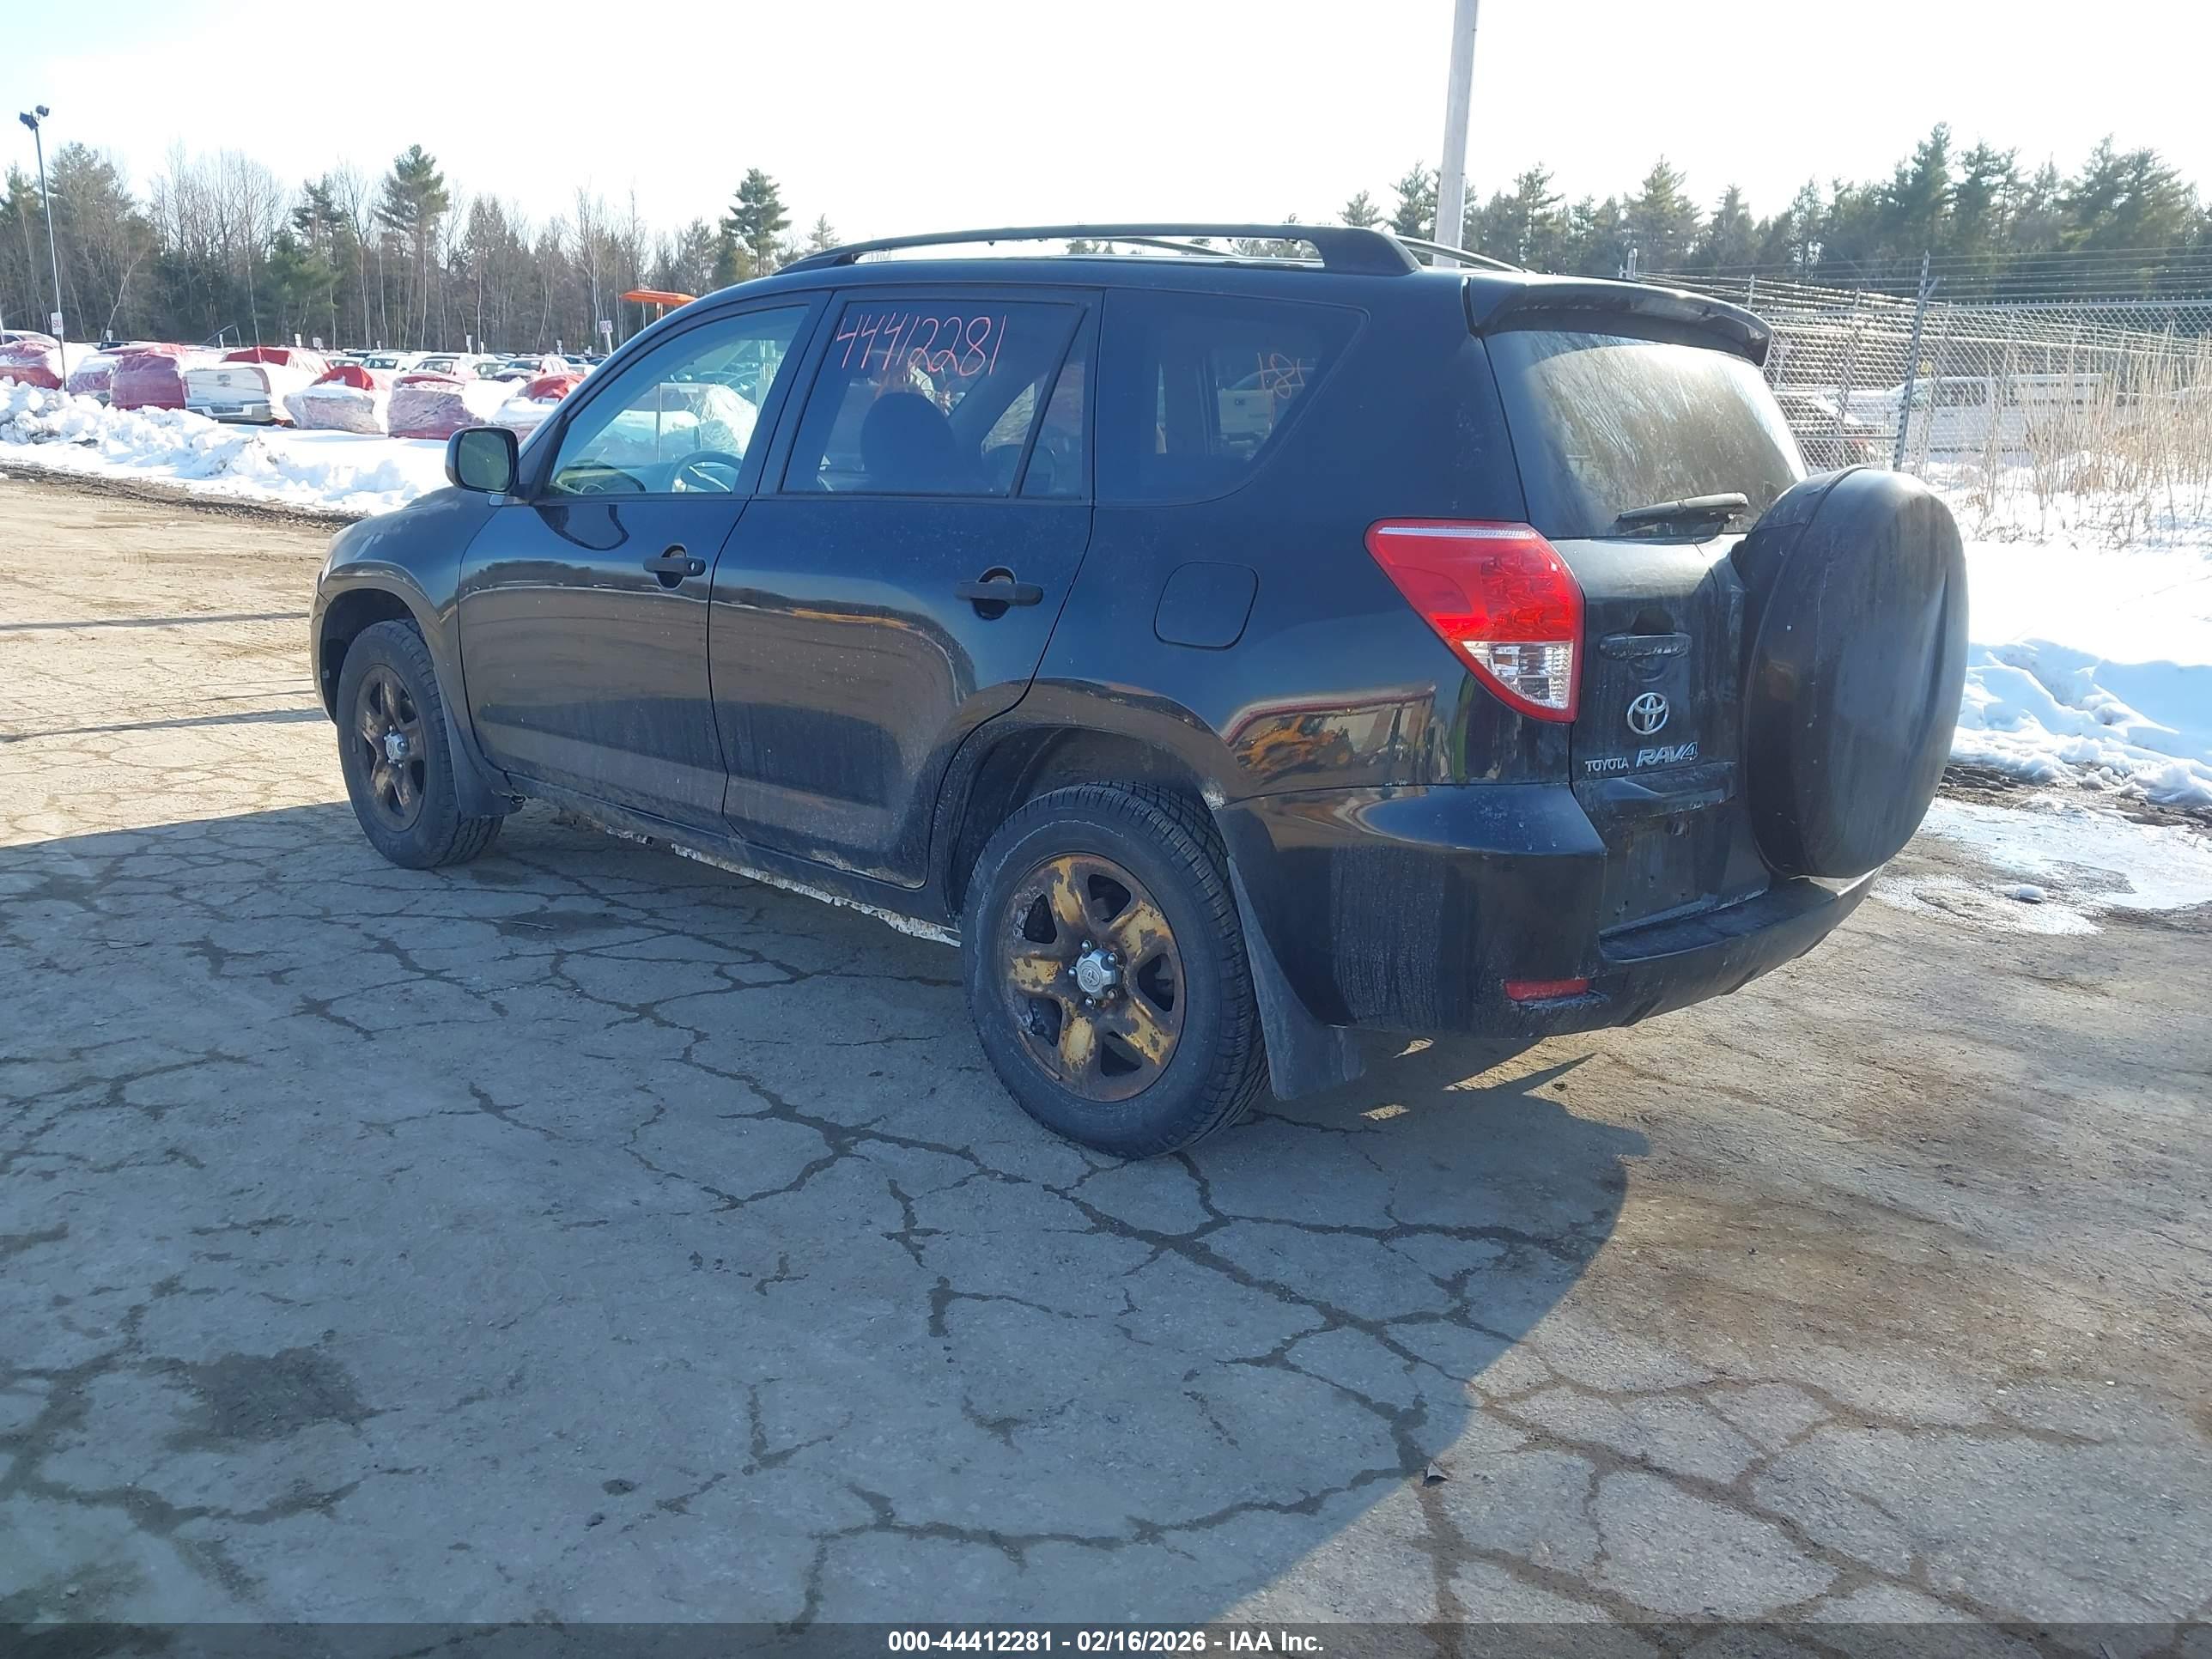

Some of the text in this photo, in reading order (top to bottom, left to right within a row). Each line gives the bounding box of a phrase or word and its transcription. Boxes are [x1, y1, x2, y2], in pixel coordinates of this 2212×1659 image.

[836, 312, 1007, 377] 44412281
[1584, 741, 1698, 772] TOYOTA RAV4
